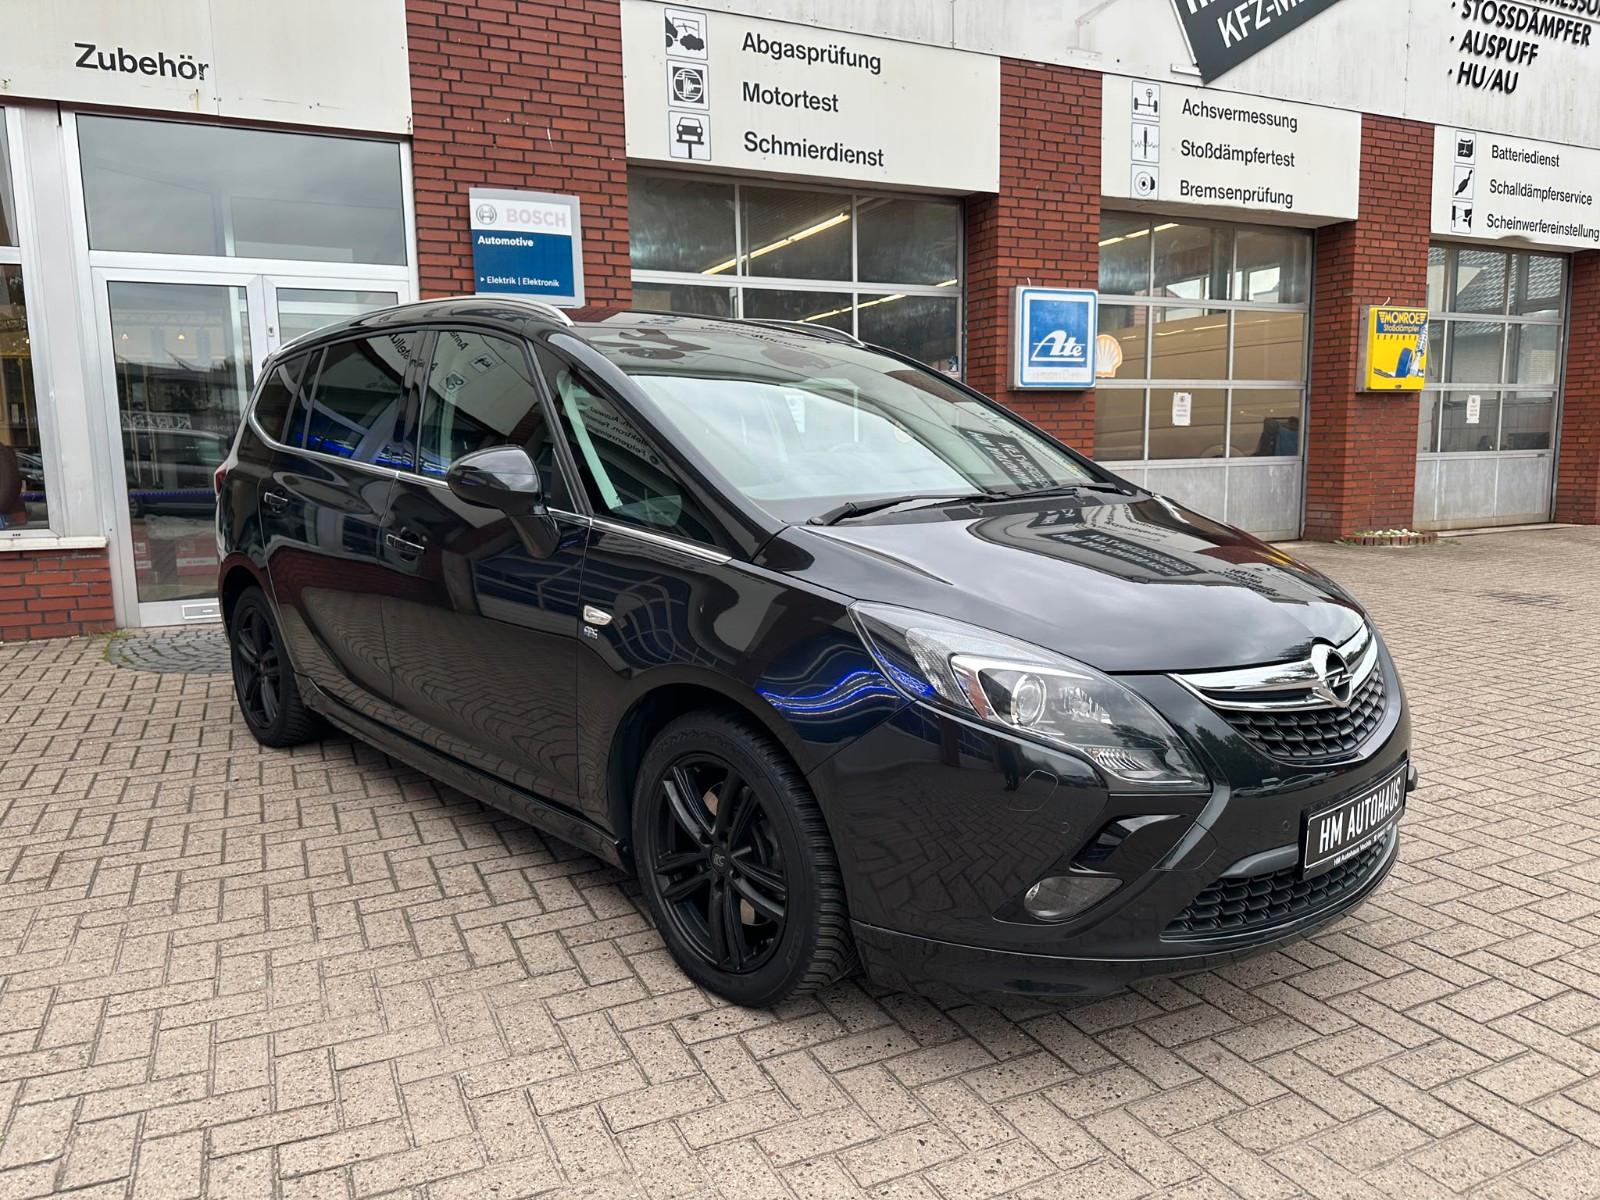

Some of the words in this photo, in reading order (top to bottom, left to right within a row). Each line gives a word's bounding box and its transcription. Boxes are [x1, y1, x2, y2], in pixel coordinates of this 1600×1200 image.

[1461, 0, 1592, 47] STOSSDÄMPFER
[74, 42, 209, 80] Zubehör
[742, 32, 881, 75] Abgasprüfung
[1459, 29, 1539, 66] AUSPUFF
[1457, 61, 1519, 94] HU/AU
[742, 81, 839, 112] Motortest
[1182, 98, 1298, 133] Achsvermessung
[743, 131, 884, 167] Schmierdienst
[1180, 139, 1295, 168] Stoßdämpfertest
[1491, 145, 1560, 168] Batteriedienst
[1179, 179, 1294, 209] Bremsenprüfung
[1489, 179, 1593, 206] Schalldämpferservice
[506, 208, 567, 227] BOSCH
[1486, 214, 1600, 242] Scheinwerfereinstellung
[478, 236, 534, 247] Automotive
[486, 276, 516, 285] Elektrik
[522, 278, 560, 287] Elektronik
[1381, 311, 1424, 325] MONROE
[1319, 812, 1344, 854] HM
[1346, 776, 1401, 841] AUTOHAUS
